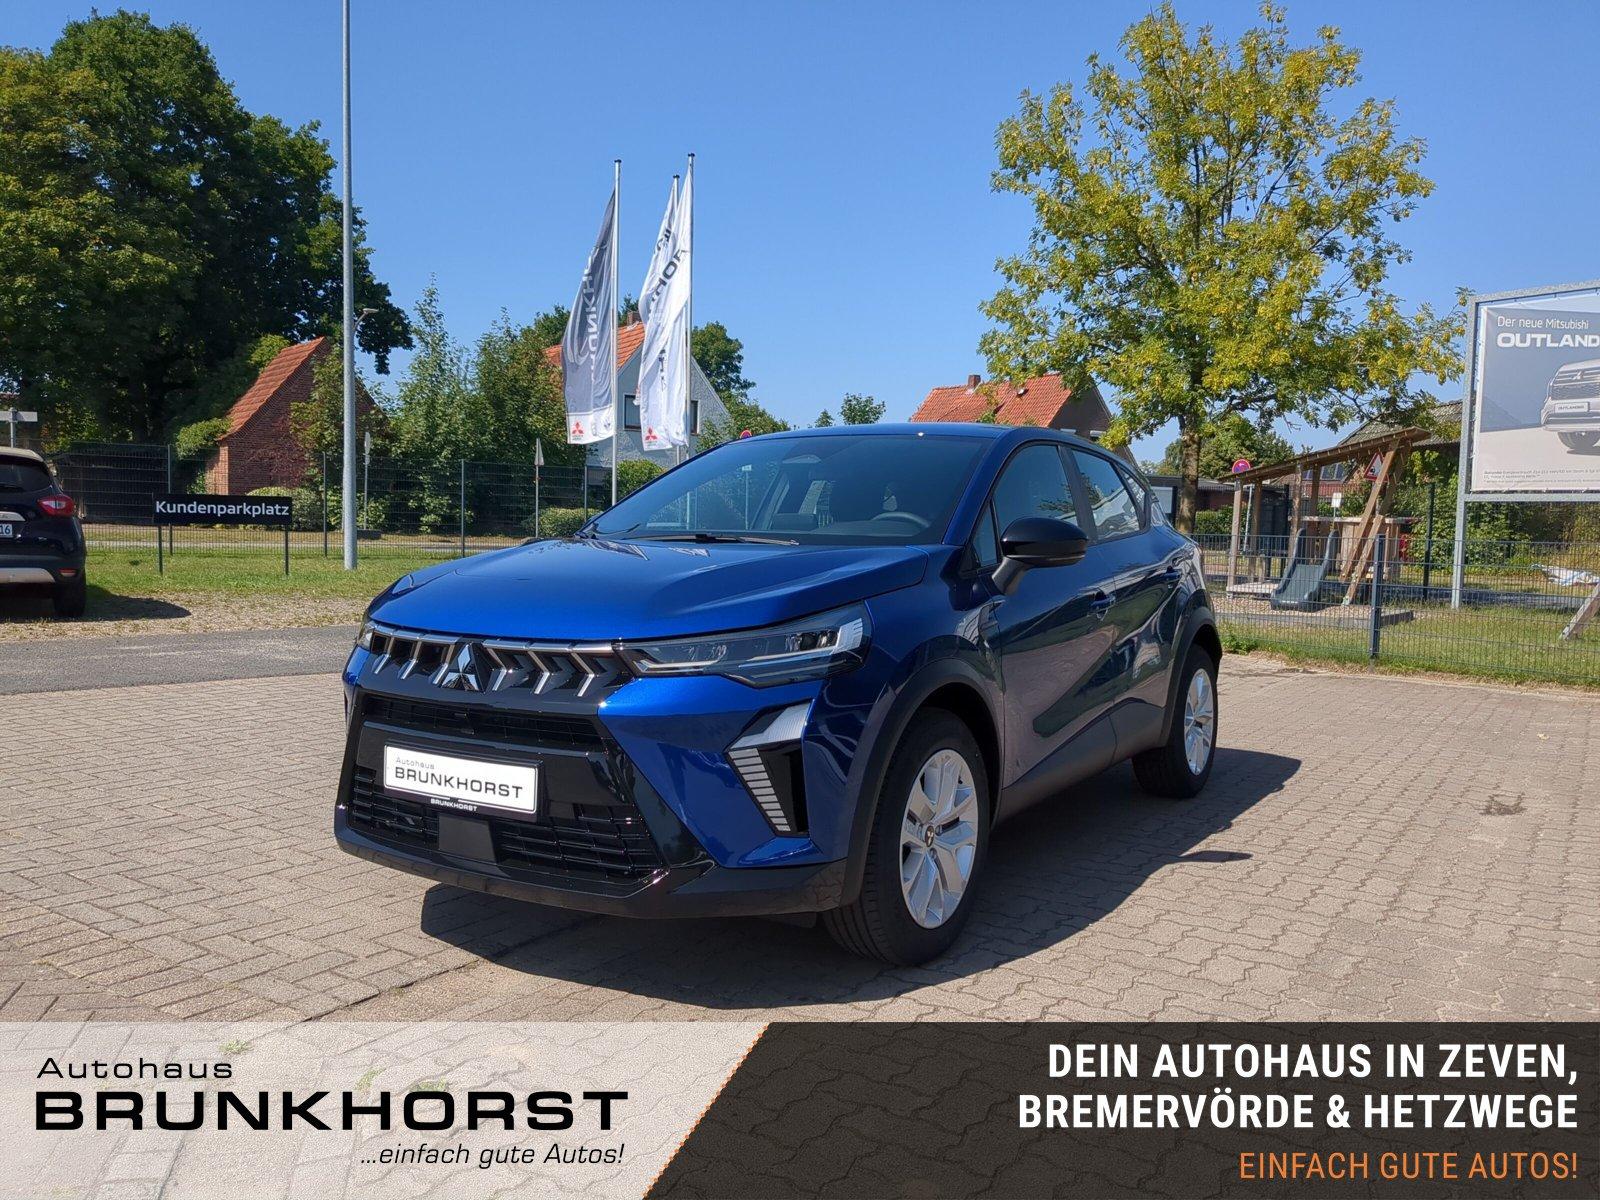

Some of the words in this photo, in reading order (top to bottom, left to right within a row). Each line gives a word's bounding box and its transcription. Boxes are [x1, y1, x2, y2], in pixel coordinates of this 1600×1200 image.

[1497, 315, 1516, 328] Der
[1518, 318, 1543, 329] neue
[1545, 318, 1589, 330] Mitsubishi
[155, 500, 289, 518] Kundenparkplatz
[395, 756, 435, 769] Autohaus
[395, 766, 523, 799] BRUNKHORST
[430, 798, 478, 812] BRUNKHORST
